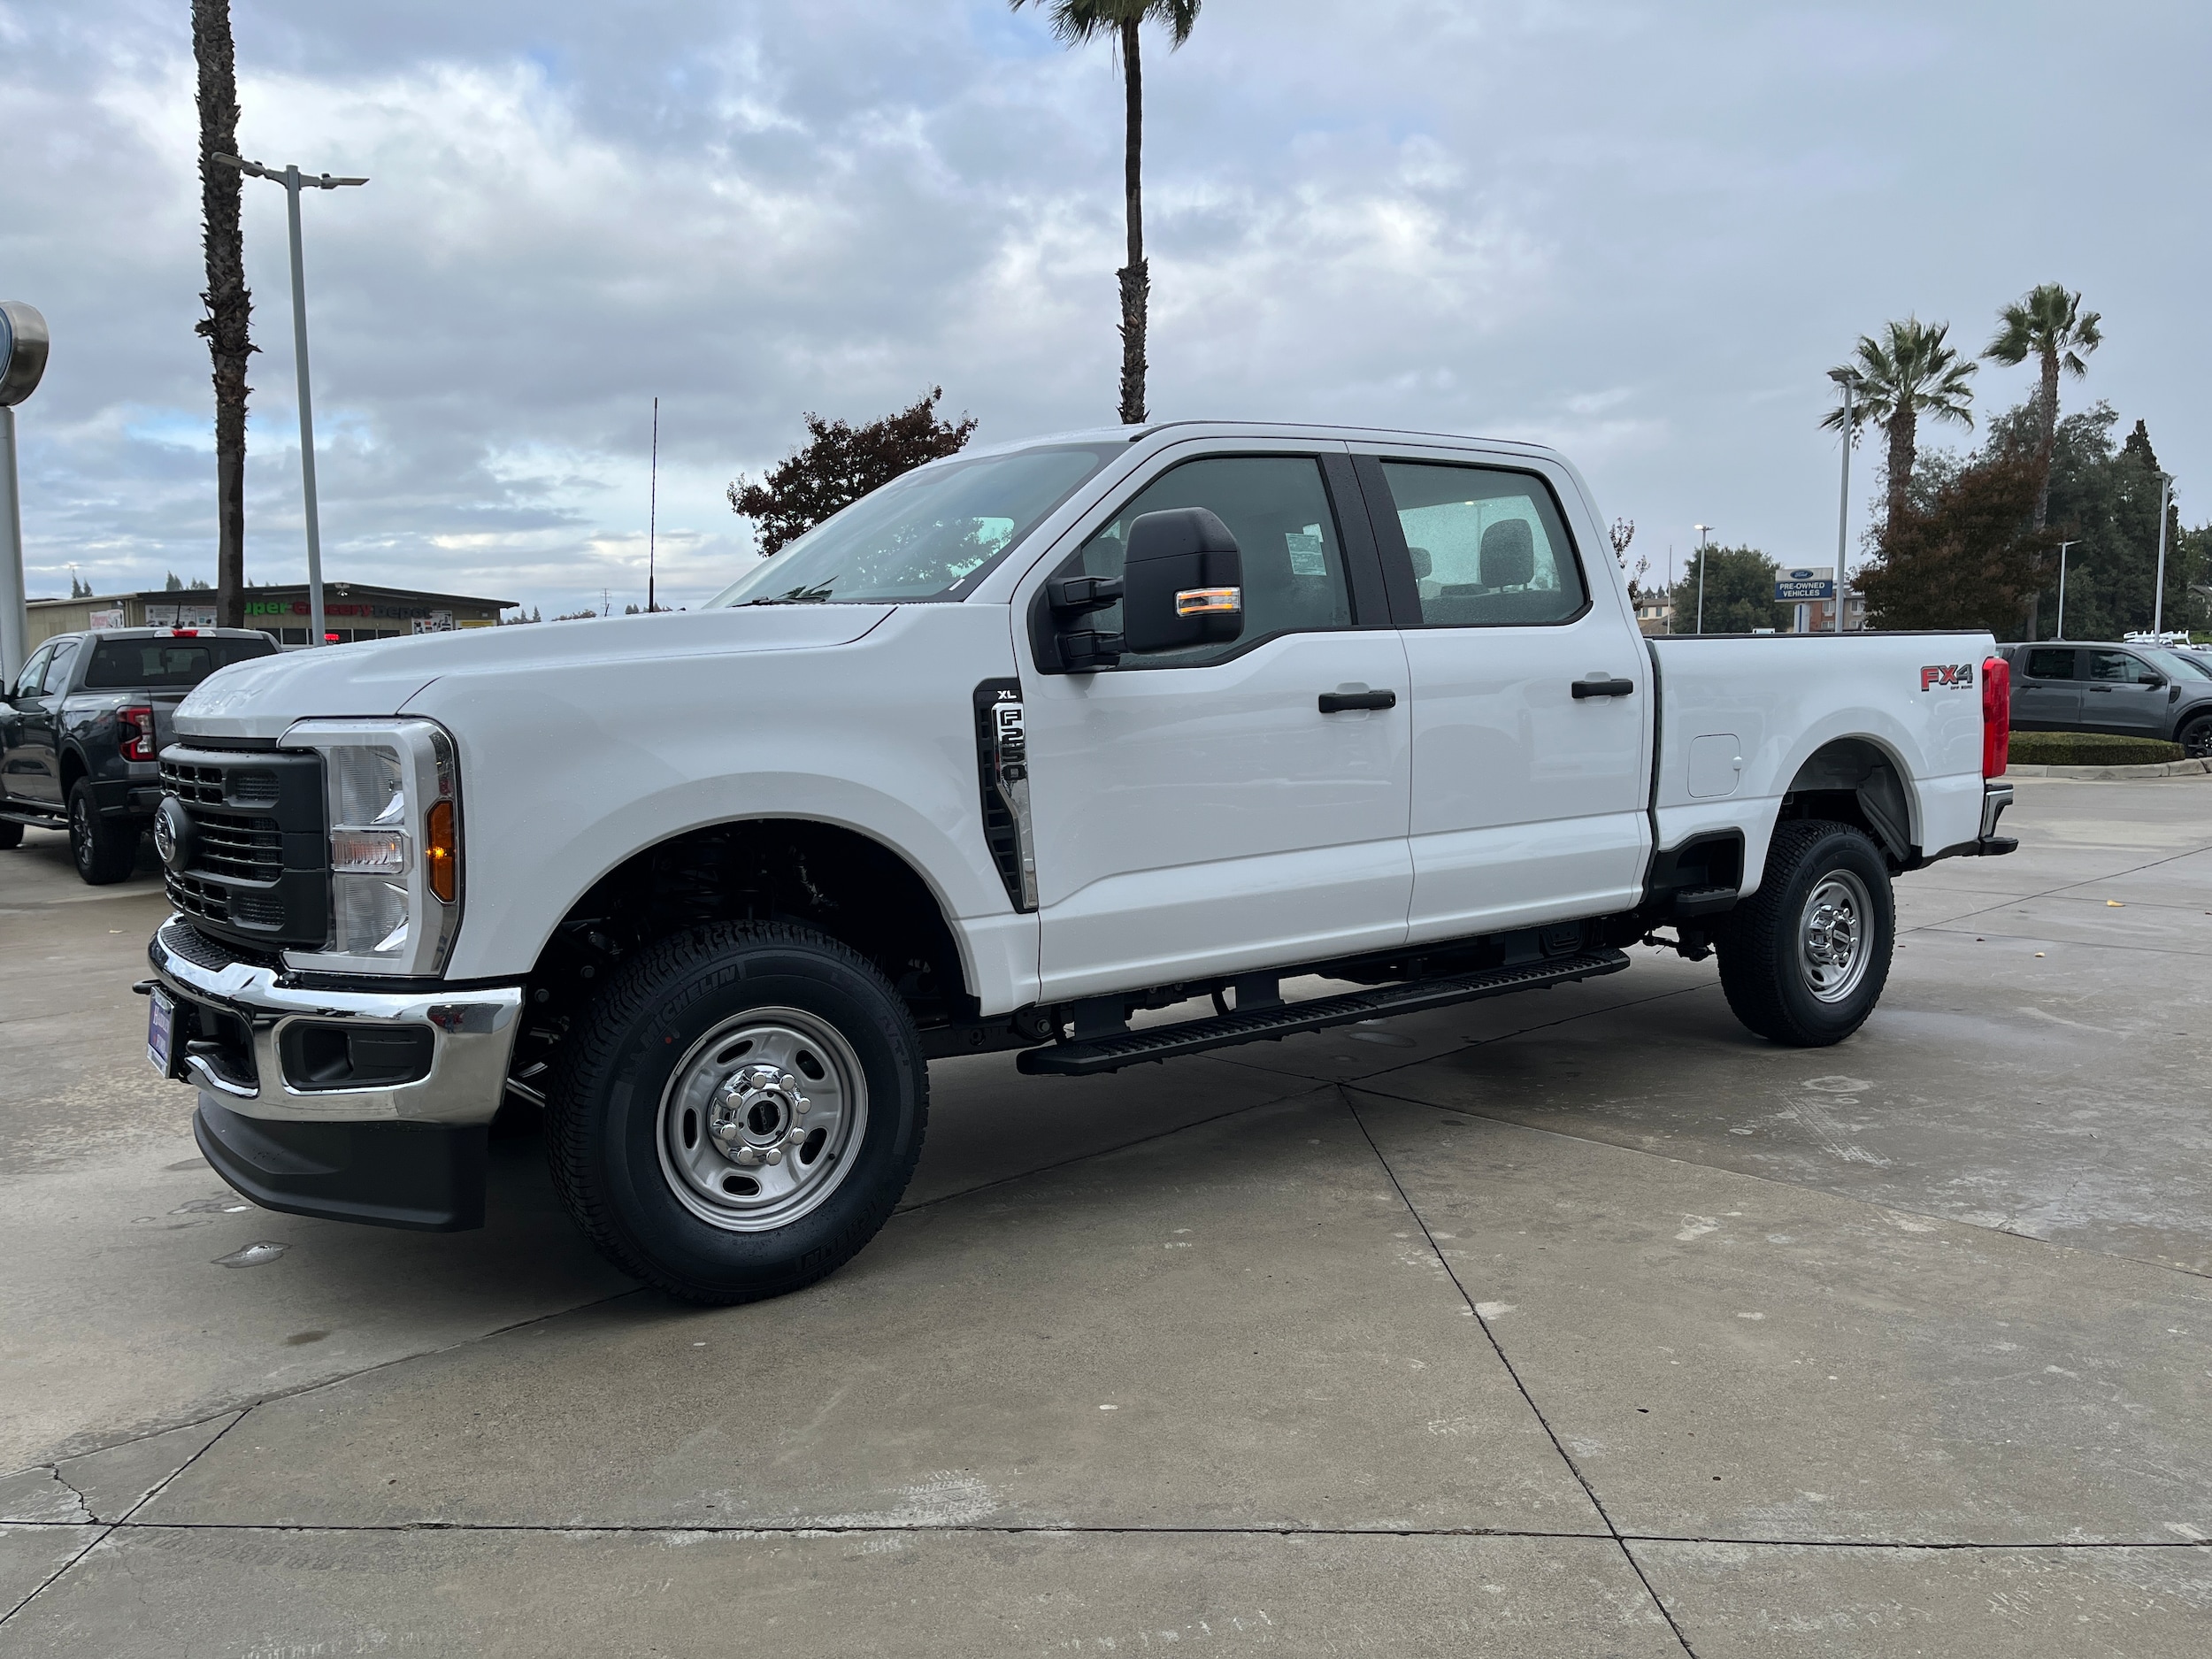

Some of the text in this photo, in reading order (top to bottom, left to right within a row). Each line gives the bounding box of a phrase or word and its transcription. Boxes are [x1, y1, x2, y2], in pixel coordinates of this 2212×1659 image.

[244, 602, 432, 618] uper Gcery Depot
[1921, 664, 1973, 692] FX4
[997, 690, 1017, 700] XL
[639, 964, 738, 1049] MICHELIN
